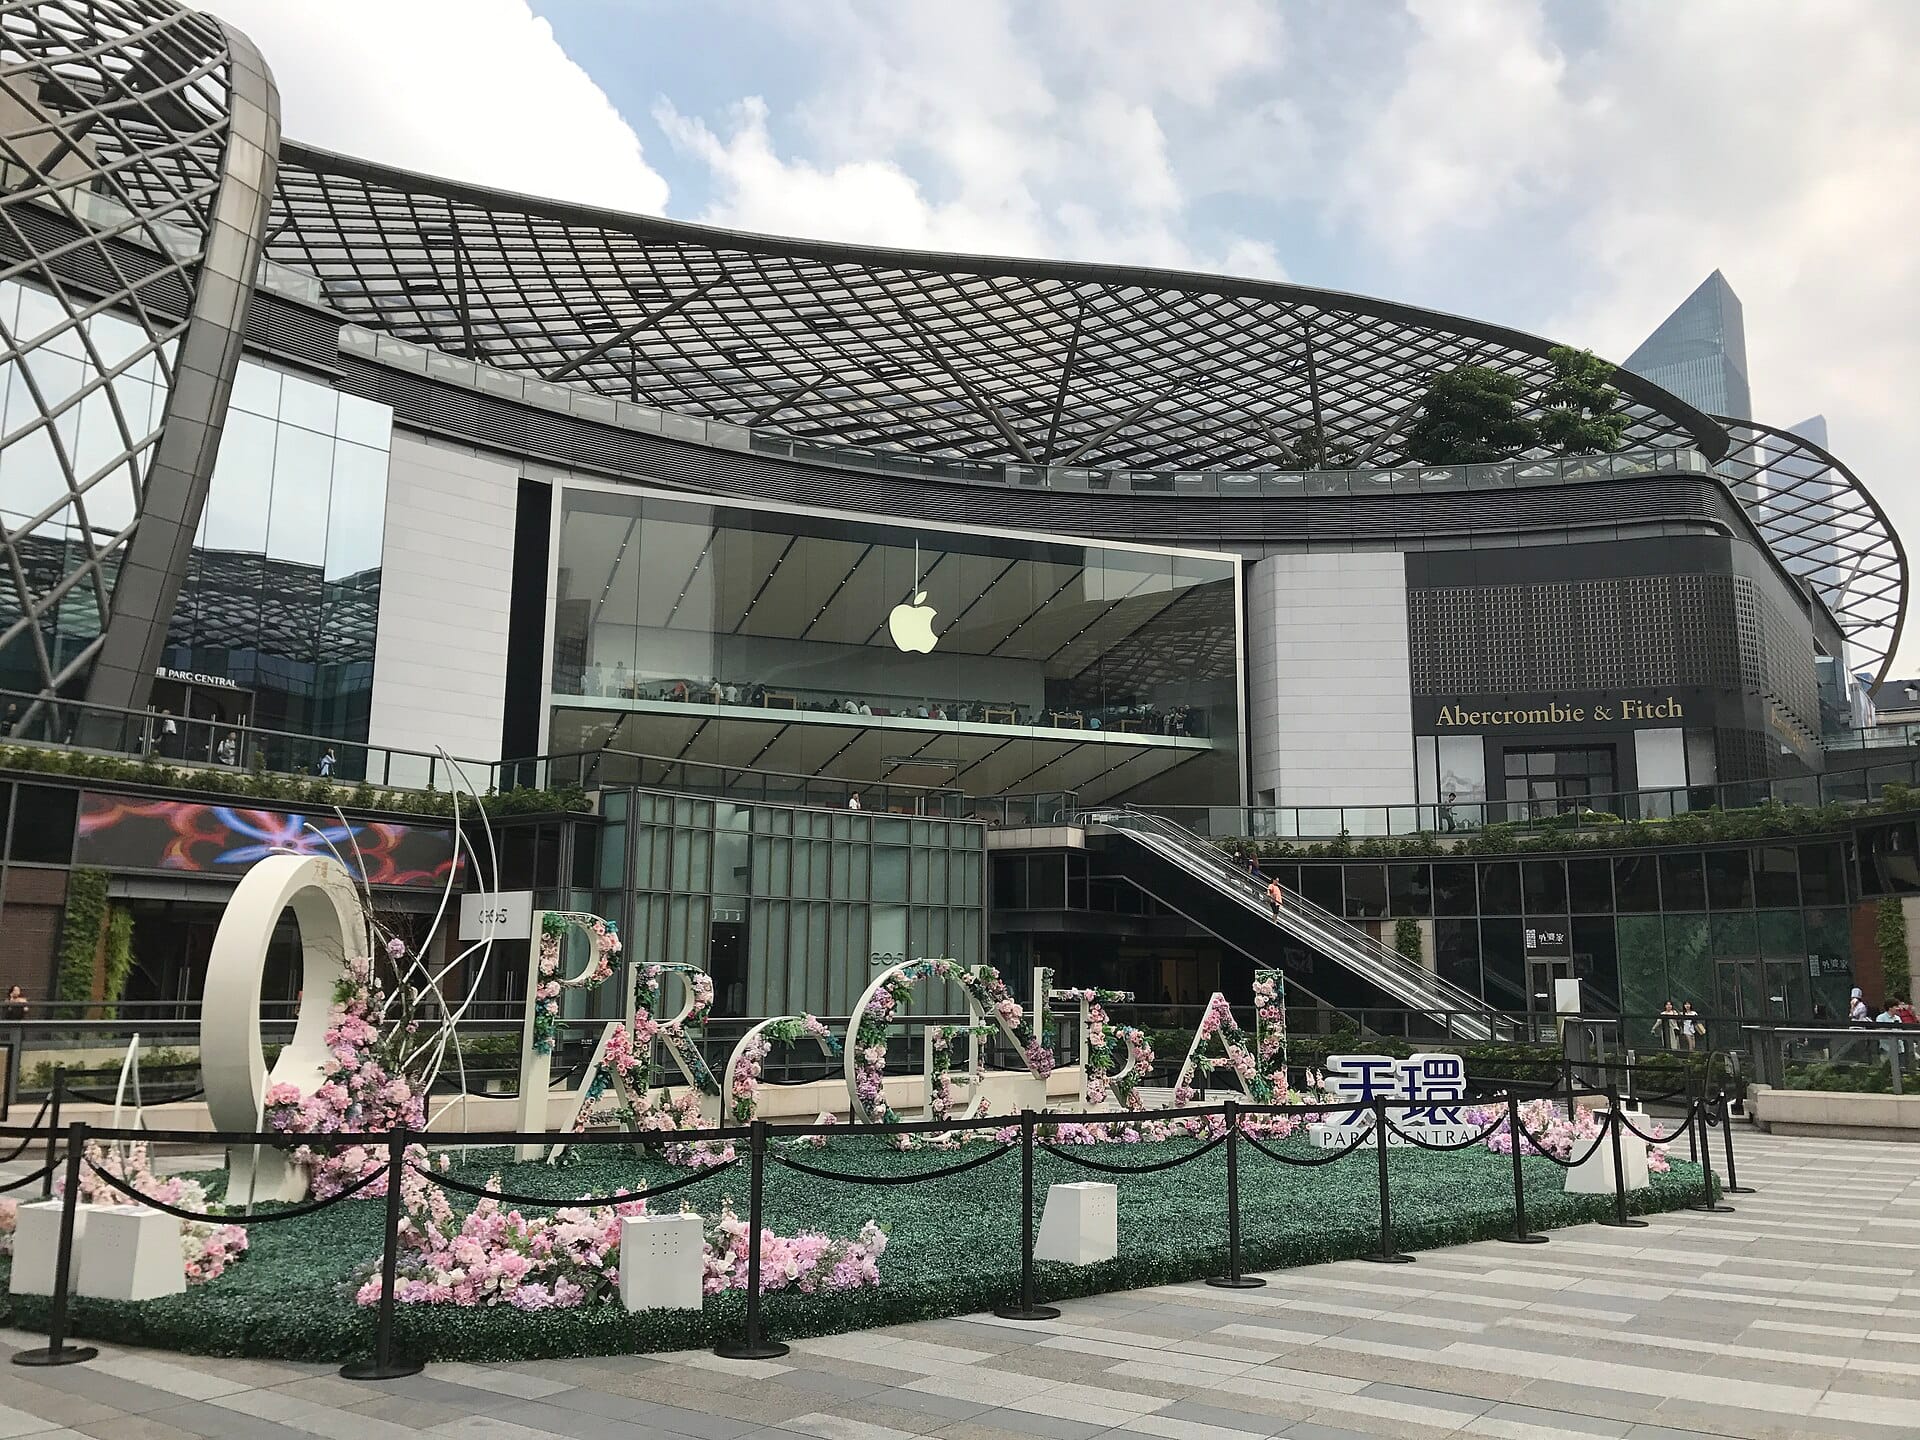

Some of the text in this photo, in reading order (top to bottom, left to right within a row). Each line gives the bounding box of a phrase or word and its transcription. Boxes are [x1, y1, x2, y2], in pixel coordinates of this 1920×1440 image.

[168, 669, 237, 688] PARC CENTRAL
[1436, 696, 1684, 726] Abercrombie & Fitch
